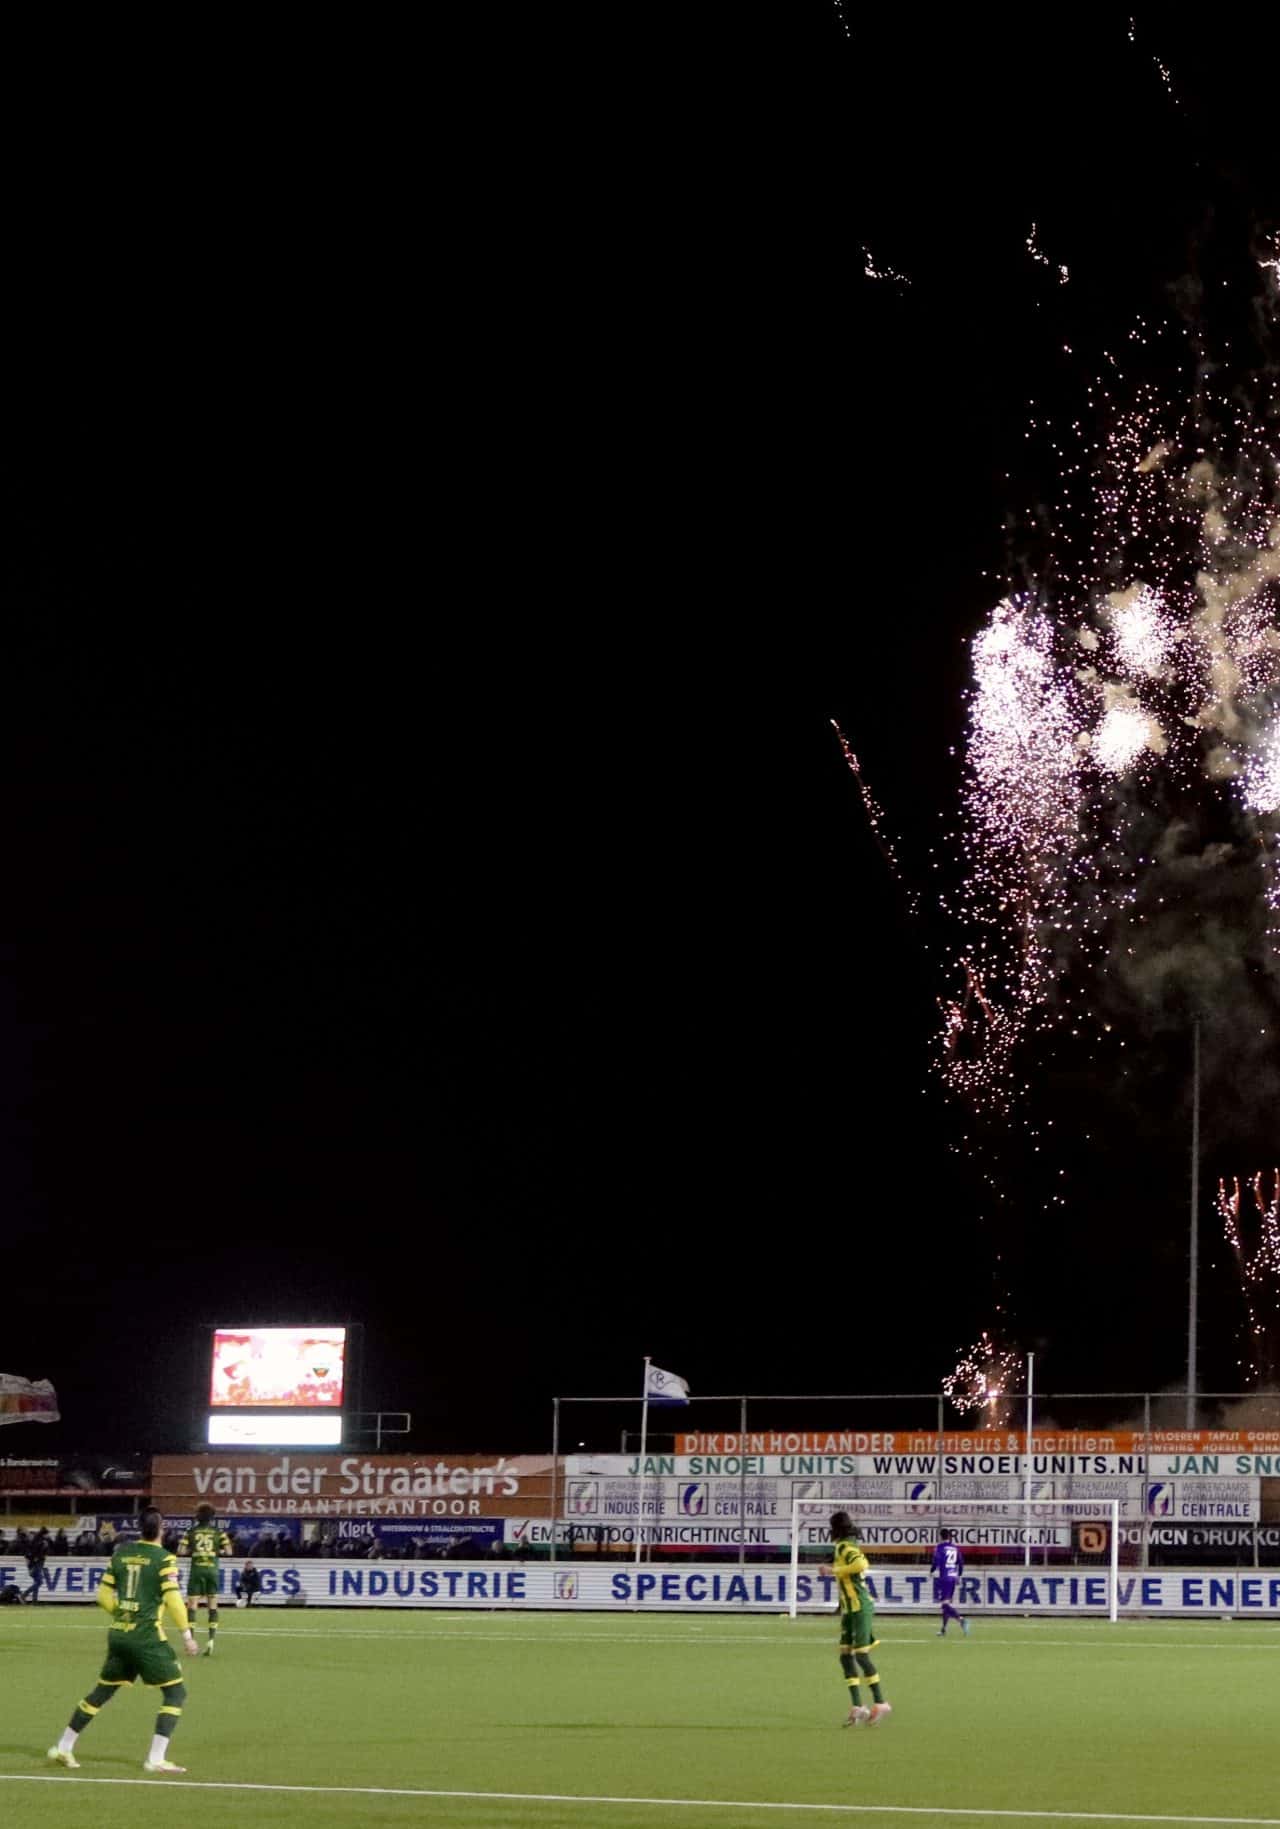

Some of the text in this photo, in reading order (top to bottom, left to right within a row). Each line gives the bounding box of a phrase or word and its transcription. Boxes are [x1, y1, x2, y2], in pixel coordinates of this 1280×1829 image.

[769, 1434, 895, 1453] HOLLANDER
[1131, 1432, 1152, 1441] PV
[1154, 1432, 1200, 1441] VLOEREN
[628, 1456, 855, 1475] JAN SNOEI UNITS
[1167, 1455, 1220, 1475] JAN
[192, 1457, 519, 1497] van der Straaten's
[226, 1499, 481, 1516] ASSURANTIEKANTOOR
[604, 1502, 665, 1515] INDUSTRIE
[715, 1502, 777, 1515] CENTRALE
[1182, 1503, 1250, 1517] CENTRALE
[338, 1520, 376, 1538] Klerk
[194, 1533, 214, 1552] 25
[328, 1569, 526, 1599] INDUSTRIE
[611, 1573, 838, 1603] SPECIALIST
